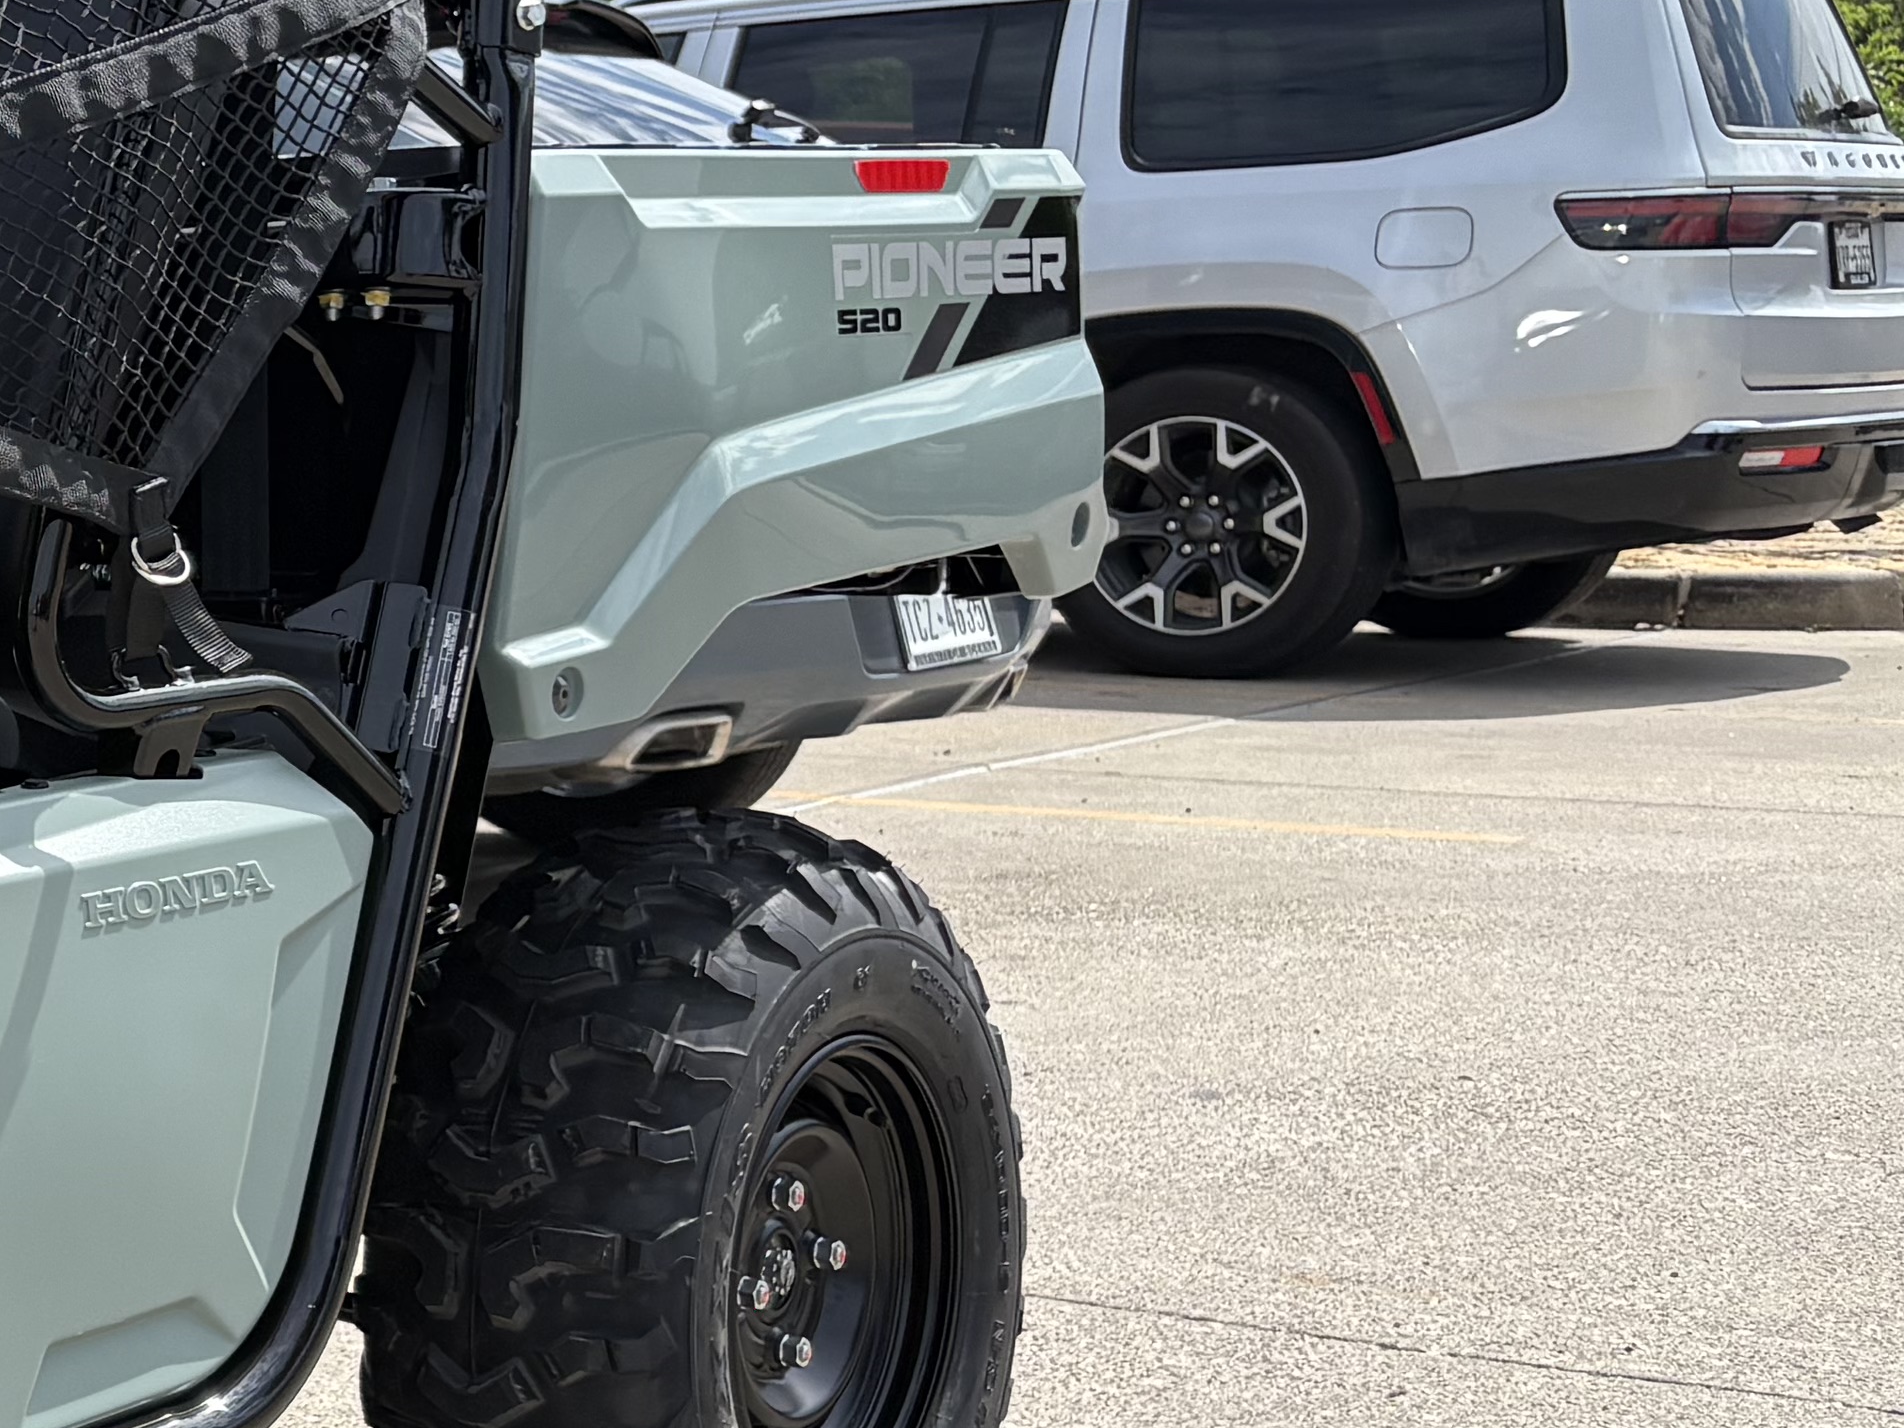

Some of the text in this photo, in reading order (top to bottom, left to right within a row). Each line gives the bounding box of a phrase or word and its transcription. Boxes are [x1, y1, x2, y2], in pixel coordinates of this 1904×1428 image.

[832, 237, 1066, 300] PIONEER
[837, 307, 902, 335] 520
[79, 860, 275, 929] HONDA
